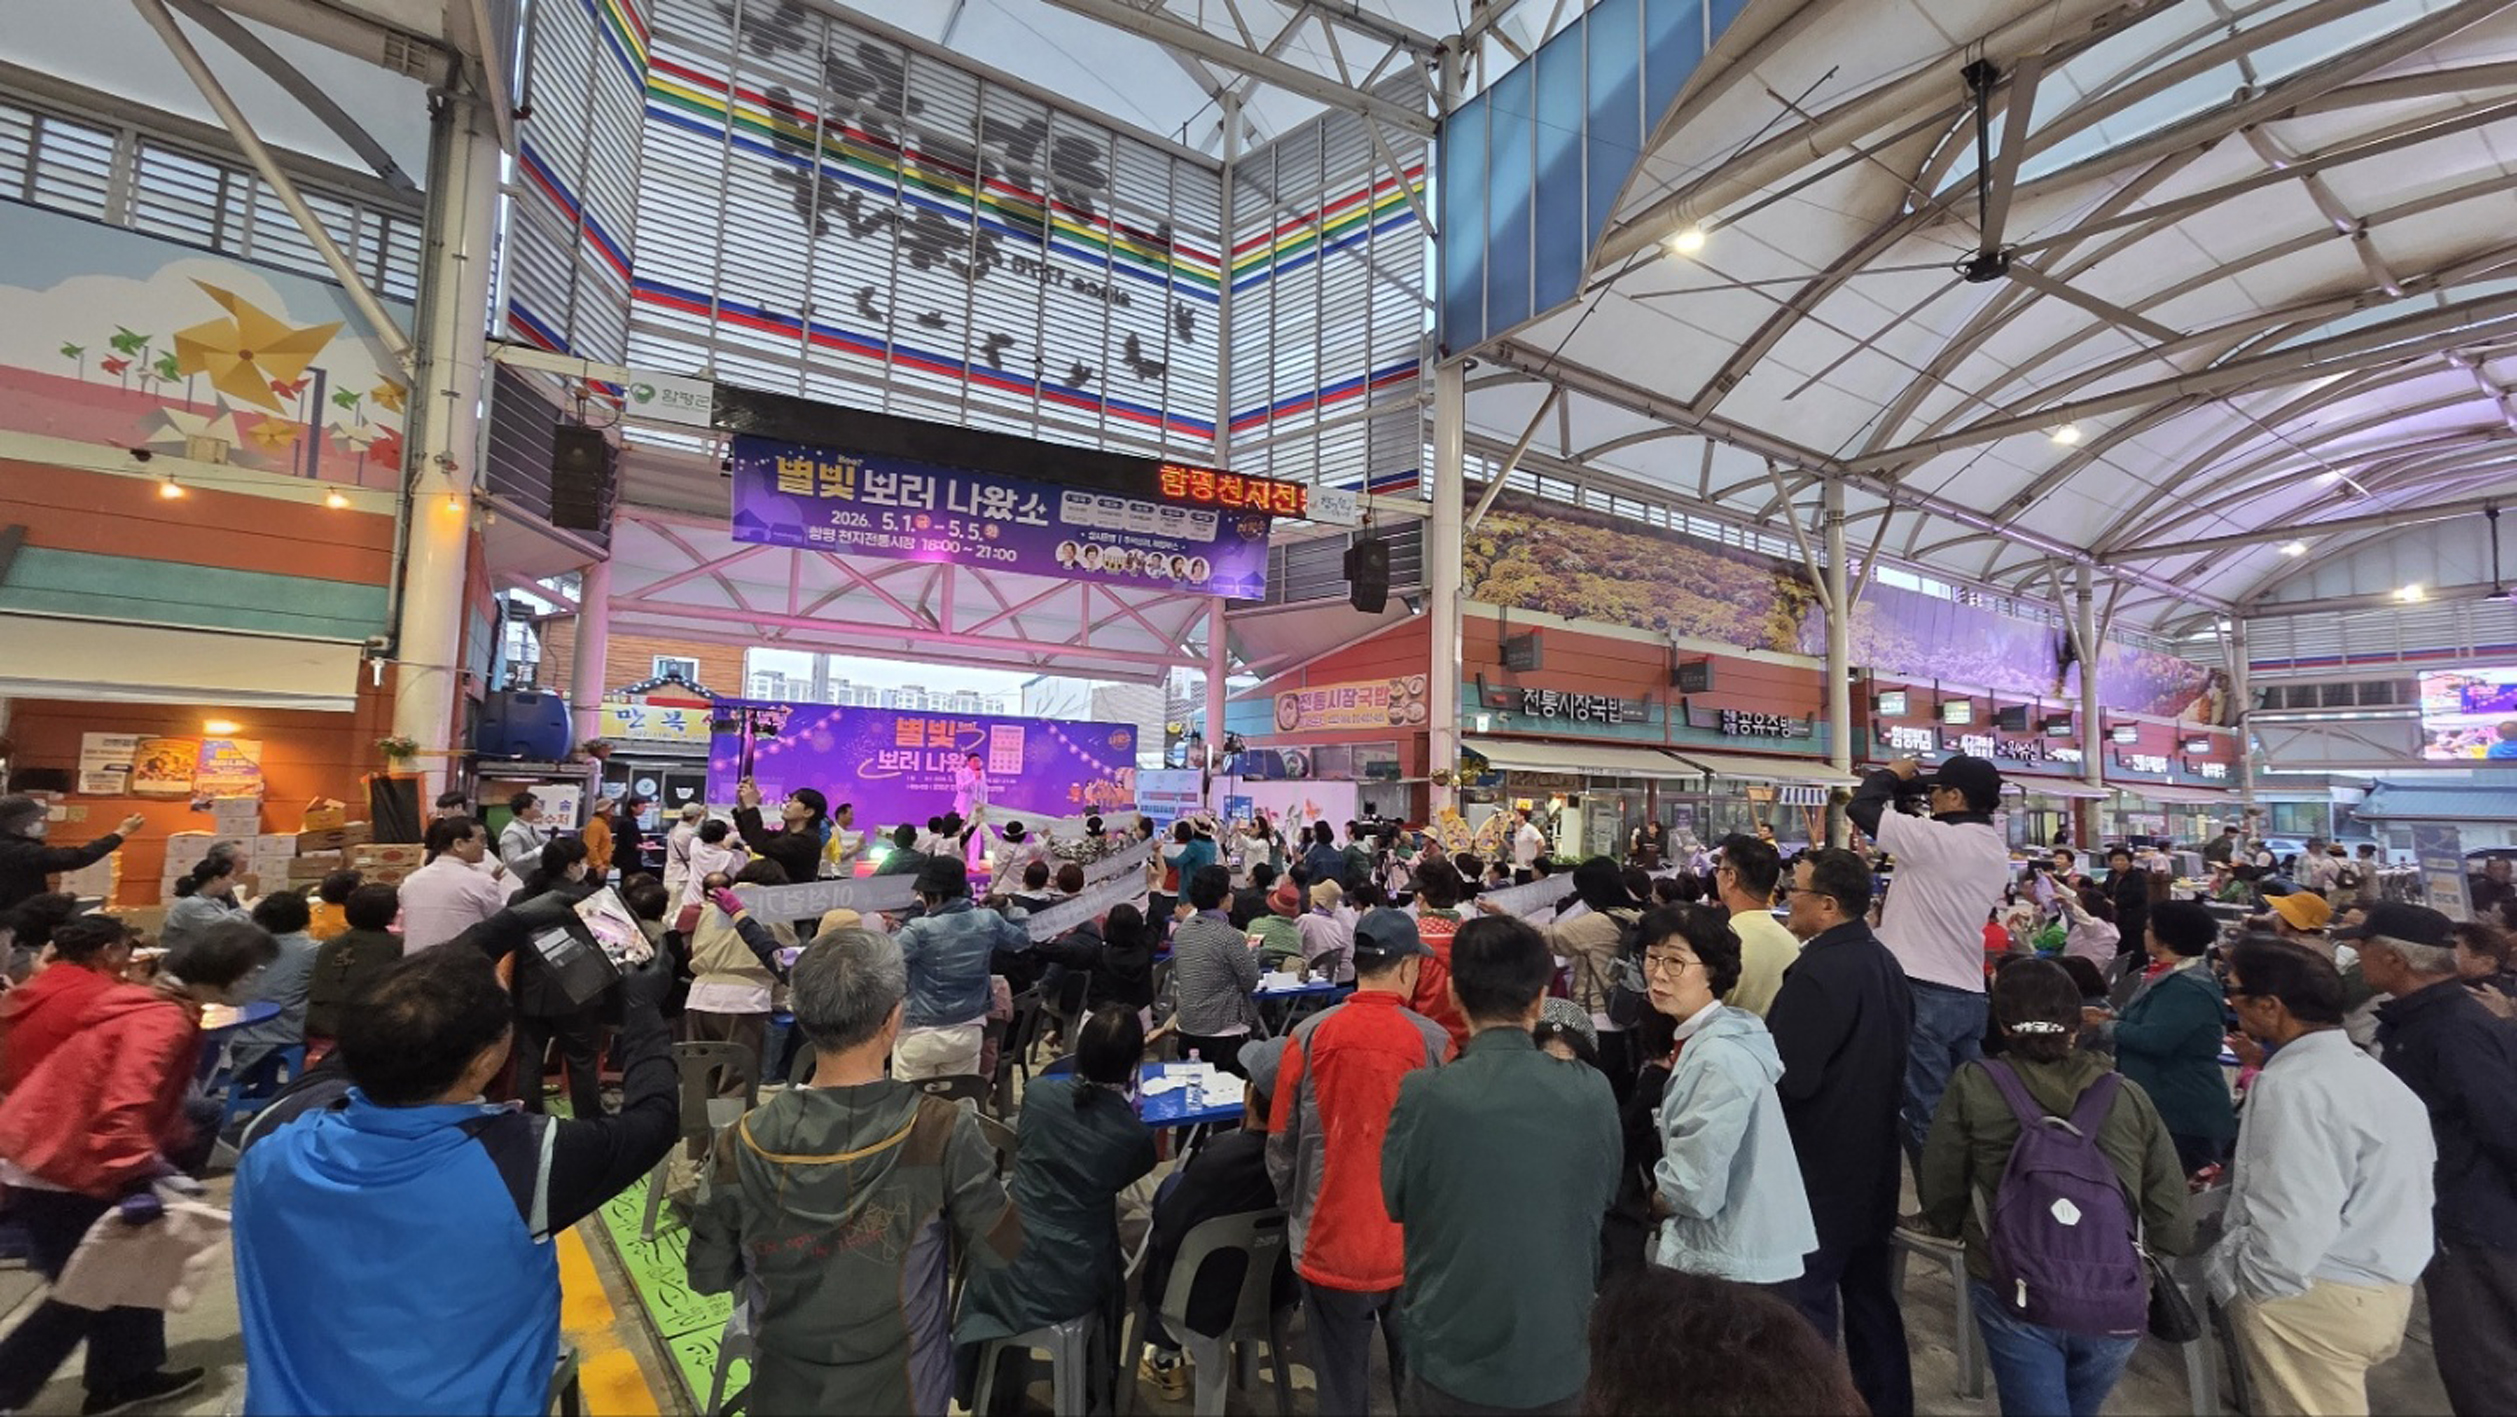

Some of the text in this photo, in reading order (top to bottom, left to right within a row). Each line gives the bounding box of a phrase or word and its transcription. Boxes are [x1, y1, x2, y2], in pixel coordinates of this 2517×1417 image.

[662, 388, 710, 409] 함평군
[777, 456, 856, 501] 별빛
[861, 469, 936, 511] 보러
[947, 479, 1049, 527] 나왔소
[1160, 464, 1308, 514] 함평천지전
[830, 510, 872, 529] 2026.
[808, 525, 836, 542] 함평
[838, 528, 916, 550] 천지전통시장
[921, 537, 960, 554] 18:00
[976, 544, 1017, 562] 21:00
[1299, 686, 1390, 713] 전통시장국밥
[1523, 688, 1625, 723] 전통시장국밥
[896, 716, 956, 749] 별빛
[1738, 710, 1792, 738] 공유주방
[877, 749, 968, 773] 보러 나왔
